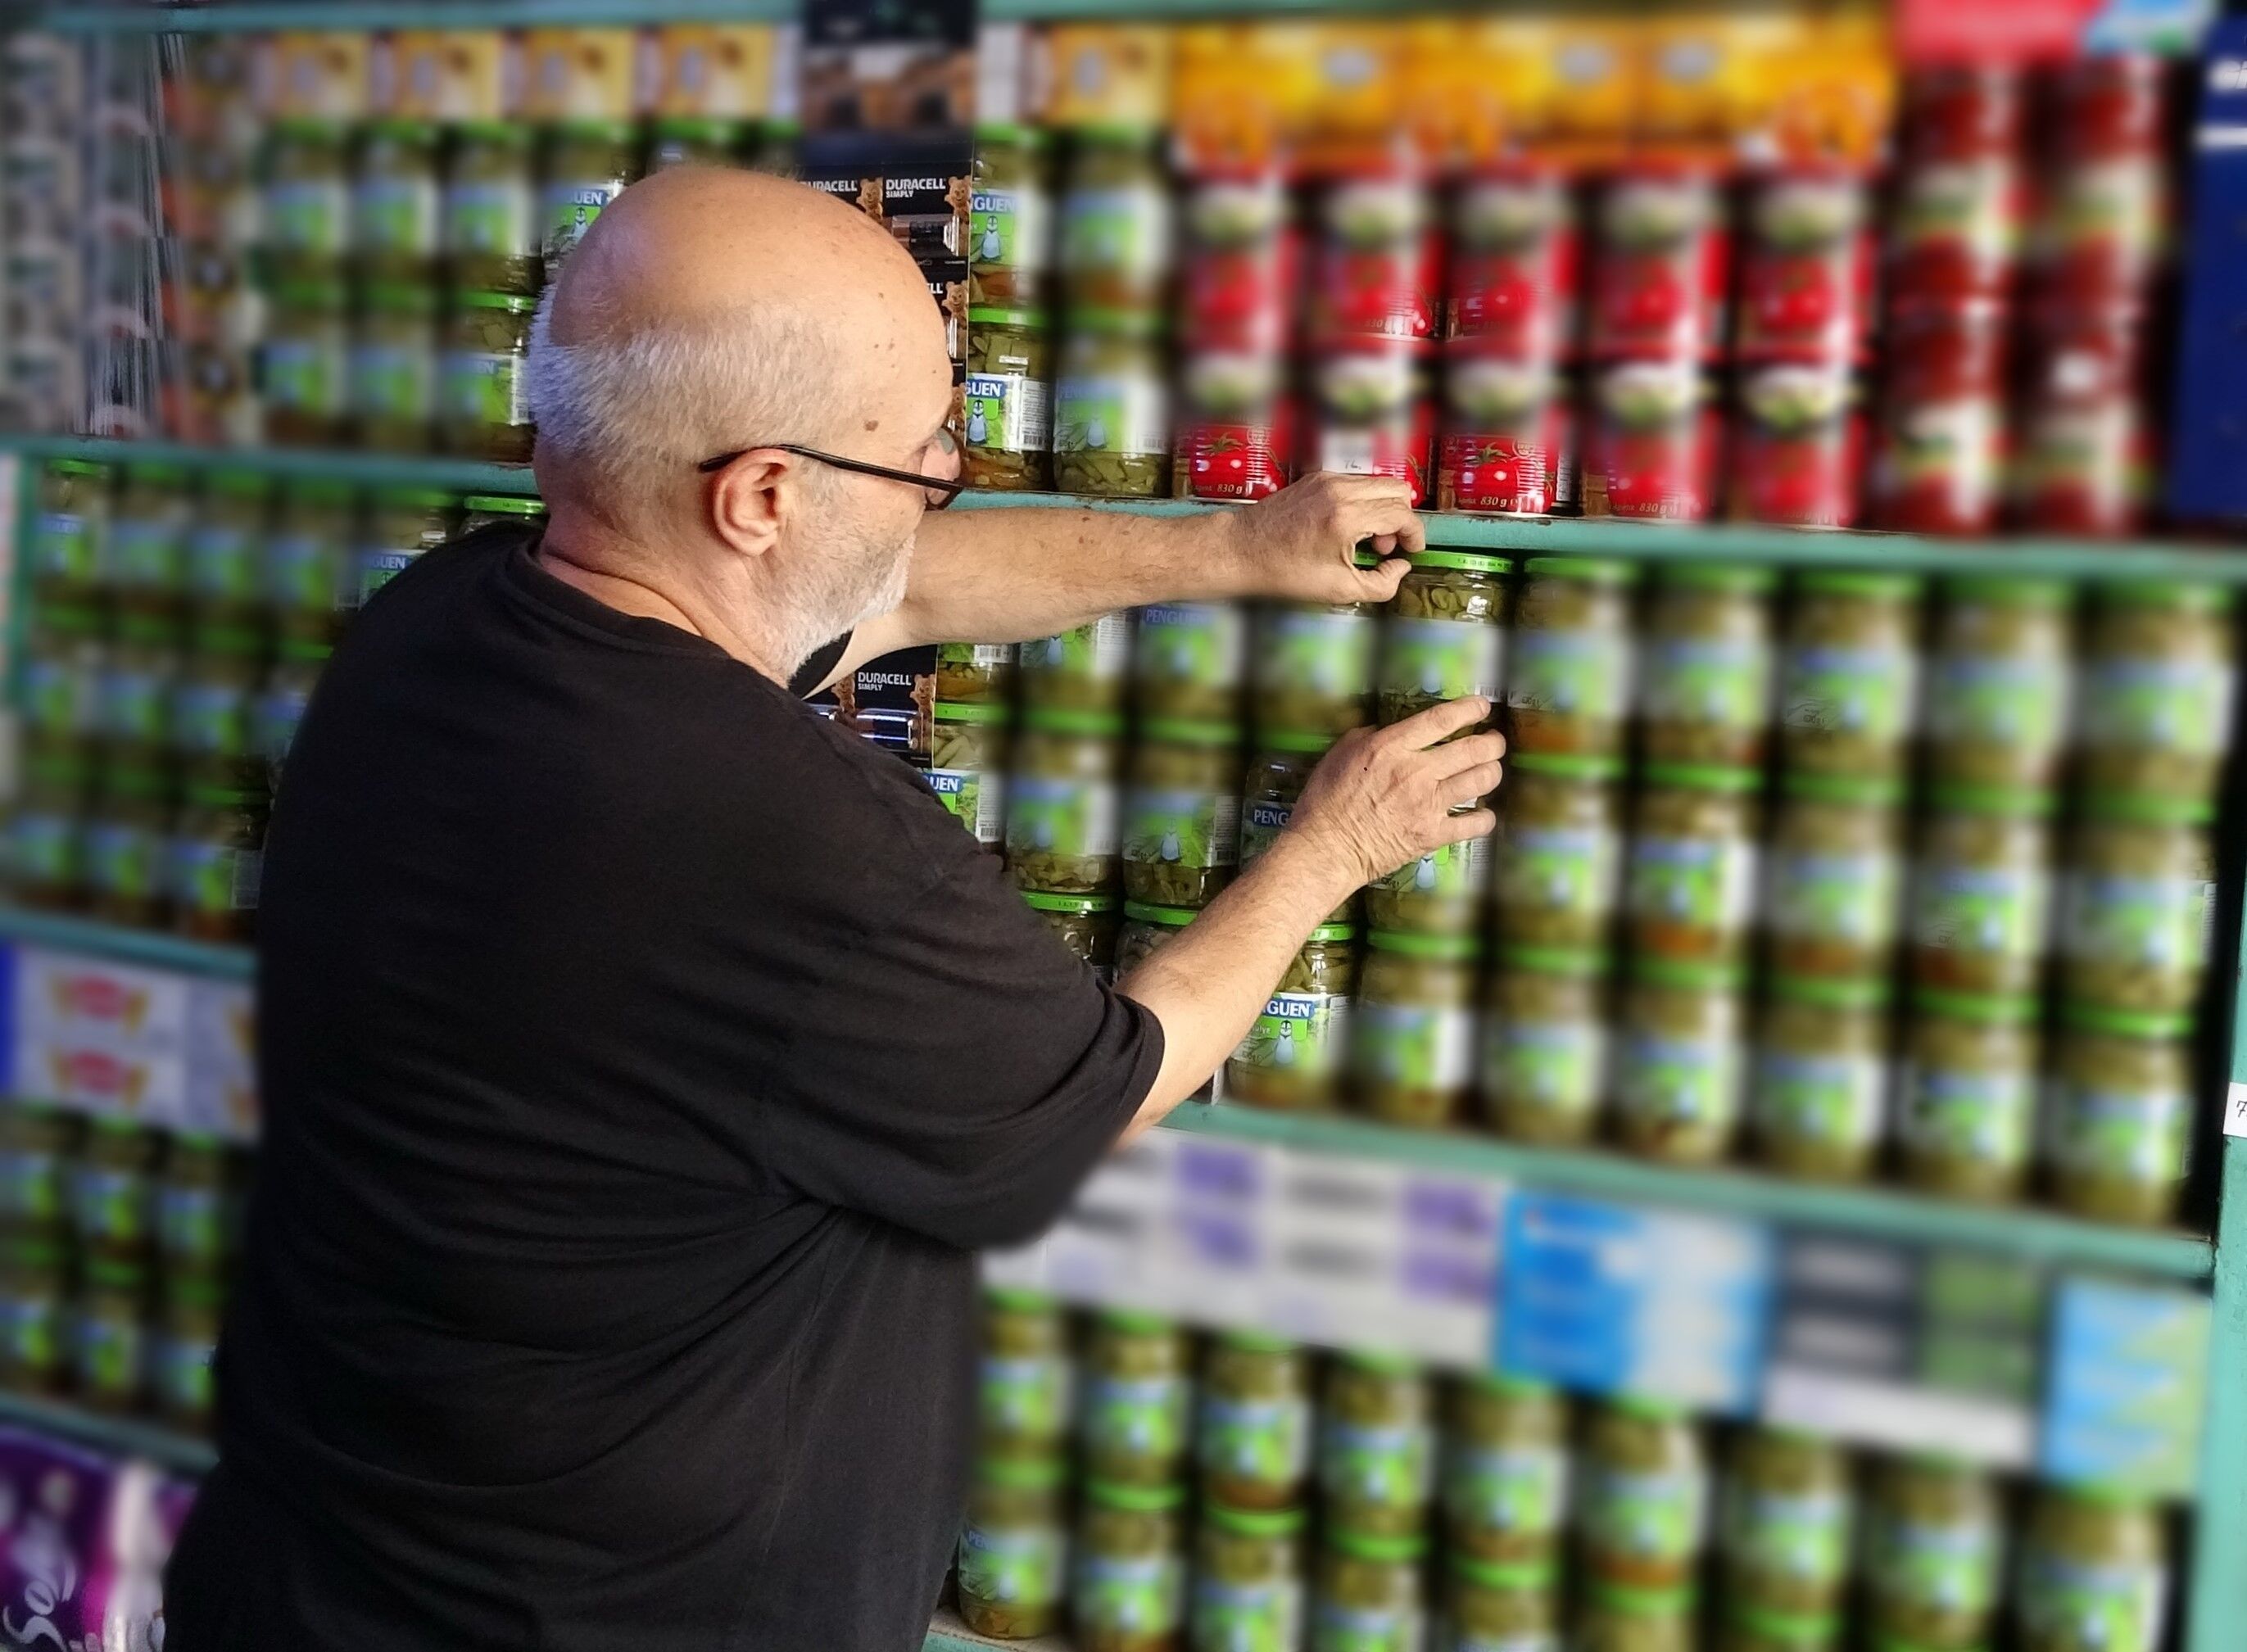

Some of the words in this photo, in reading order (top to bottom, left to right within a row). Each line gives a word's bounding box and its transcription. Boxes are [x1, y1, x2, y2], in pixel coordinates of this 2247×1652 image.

[886, 178, 946, 190] DURACELL
[886, 190, 914, 198] SIMPLY
[1217, 483, 1234, 493] 830
[1235, 486, 1244, 495] g
[1480, 496, 1498, 506] 830
[1500, 498, 1507, 508] g
[1639, 503, 1659, 513] 830
[858, 672, 912, 686] DURACELL
[858, 683, 883, 691] SIMPLY
[1262, 1000, 1312, 1017] GUEN
